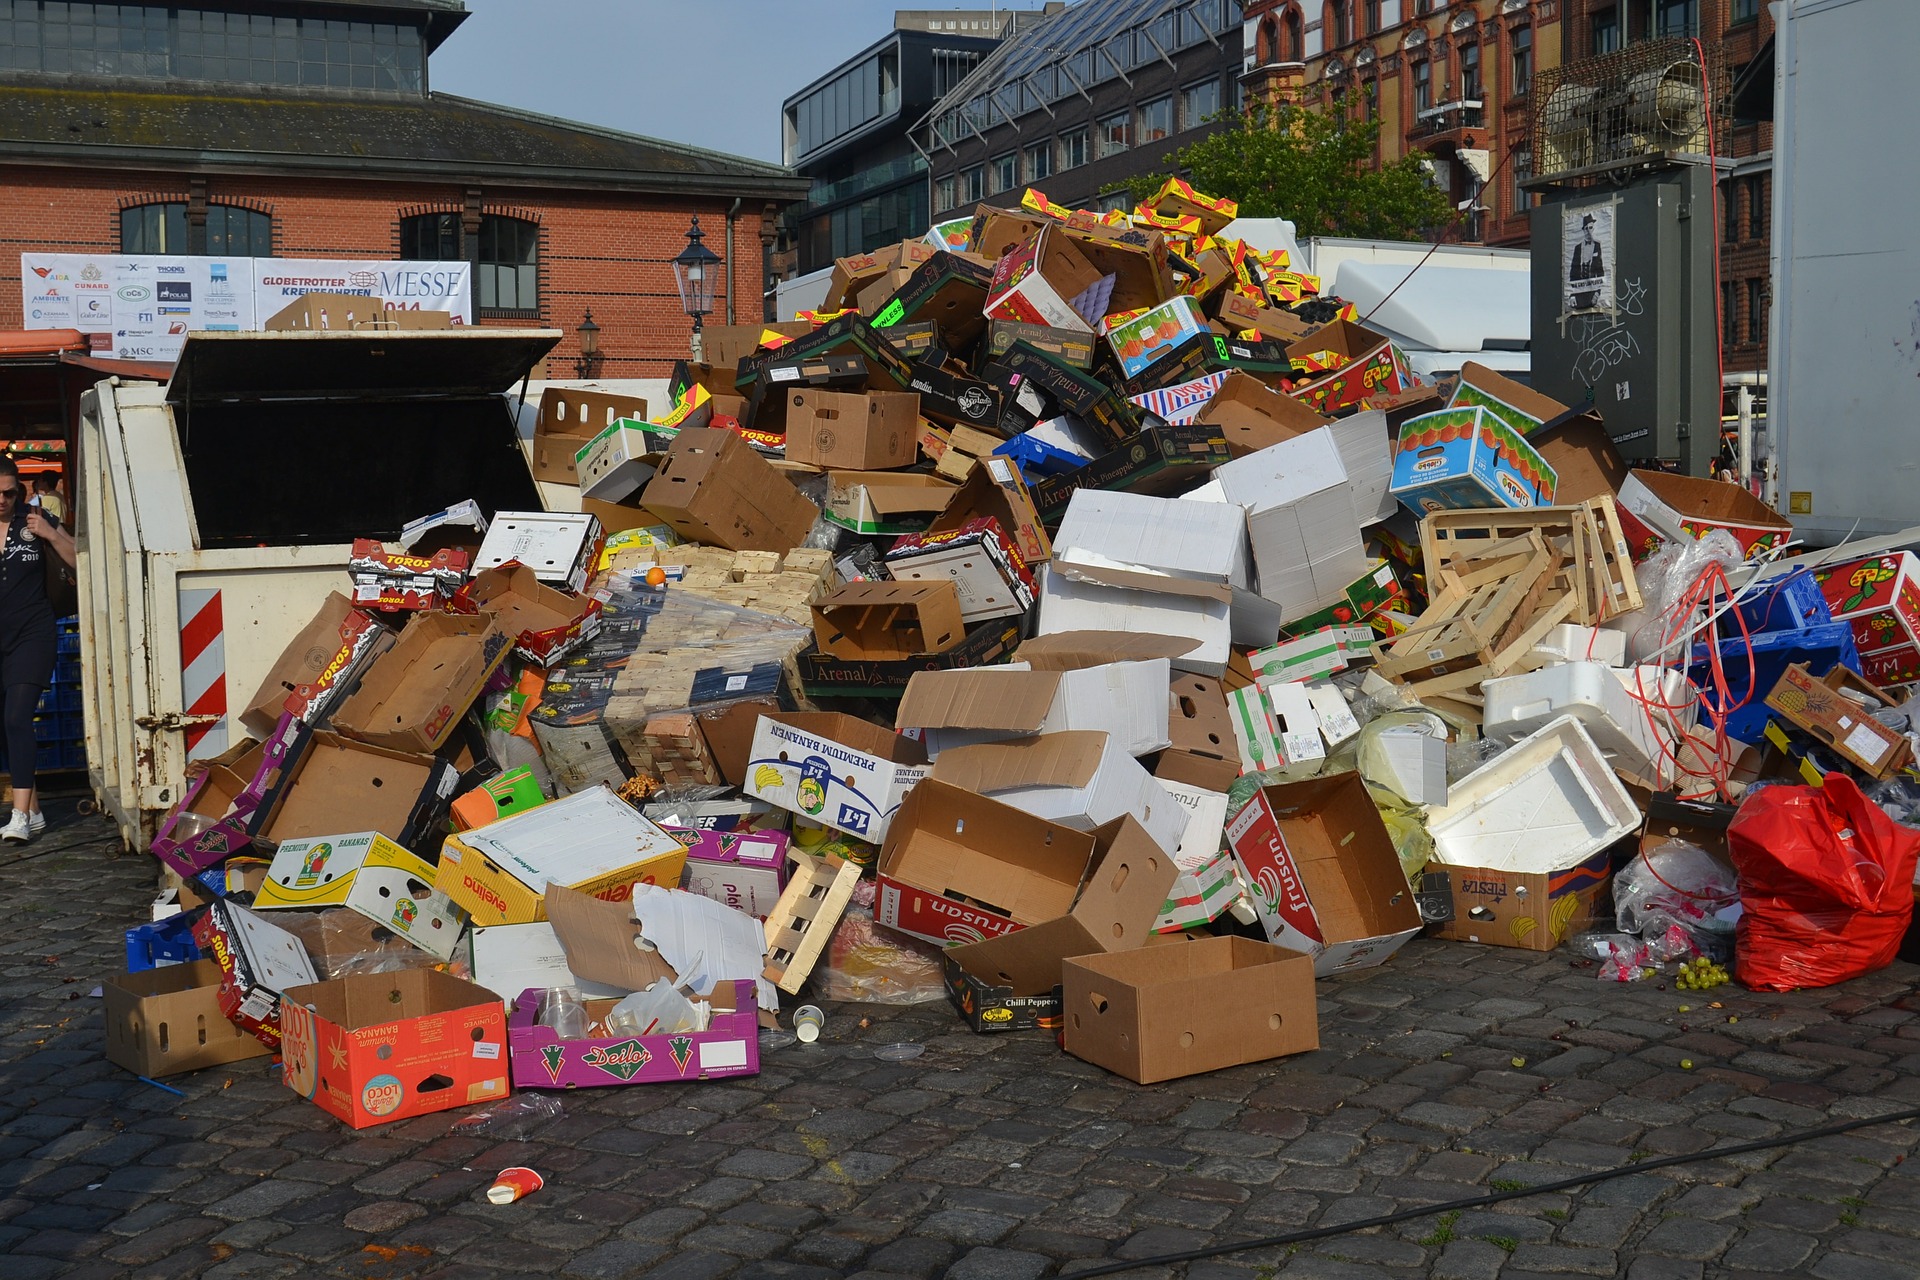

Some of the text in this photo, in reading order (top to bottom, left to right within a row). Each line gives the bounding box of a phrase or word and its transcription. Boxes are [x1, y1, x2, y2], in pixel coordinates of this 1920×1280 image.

[1066, 217, 1096, 233] Dole
[1151, 215, 1182, 226] SHARON
[910, 246, 935, 262] Dol
[847, 255, 876, 272] Dole
[263, 271, 462, 297] GLOBETROTTER MESSE
[138, 312, 153, 322] FTI
[1229, 298, 1260, 321] Dole
[131, 347, 154, 356] MSC
[1050, 375, 1091, 401] Arenal
[662, 402, 690, 427] SHARON
[741, 429, 782, 444] TOROS
[1043, 462, 1135, 507] Arenal Pineapple
[919, 530, 960, 545] TOROS
[1021, 523, 1041, 556] Dole
[386, 554, 432, 569] TOROS
[1007, 544, 1026, 570] TOROS
[378, 596, 405, 604] TOROS
[317, 645, 351, 688] TOROS
[817, 664, 868, 682] Arenal
[1787, 668, 1813, 691] Dole
[423, 703, 454, 742] Dole
[1855, 709, 1878, 727] SUPER
[1877, 723, 1902, 743] SWEET
[770, 725, 876, 772] PREMIUM BANANEN
[895, 769, 925, 777] BANANAS
[1230, 806, 1259, 838] APPLES
[279, 837, 370, 854] PREMIUM BANANAS
[375, 840, 393, 852] CLASS
[1462, 874, 1506, 883] BANANAS
[462, 875, 508, 914] evelina
[1461, 880, 1508, 896] FIESTA
[210, 934, 232, 973] TOROS
[1005, 998, 1058, 1008] Chilli Peppers
[281, 1003, 309, 1042] LOCO
[463, 1017, 490, 1029] UNIVEG
[355, 1024, 399, 1040] BANANAS
[358, 1034, 398, 1049] Premium
[588, 1043, 653, 1067] Deilor
[367, 1083, 399, 1101] LOCO
